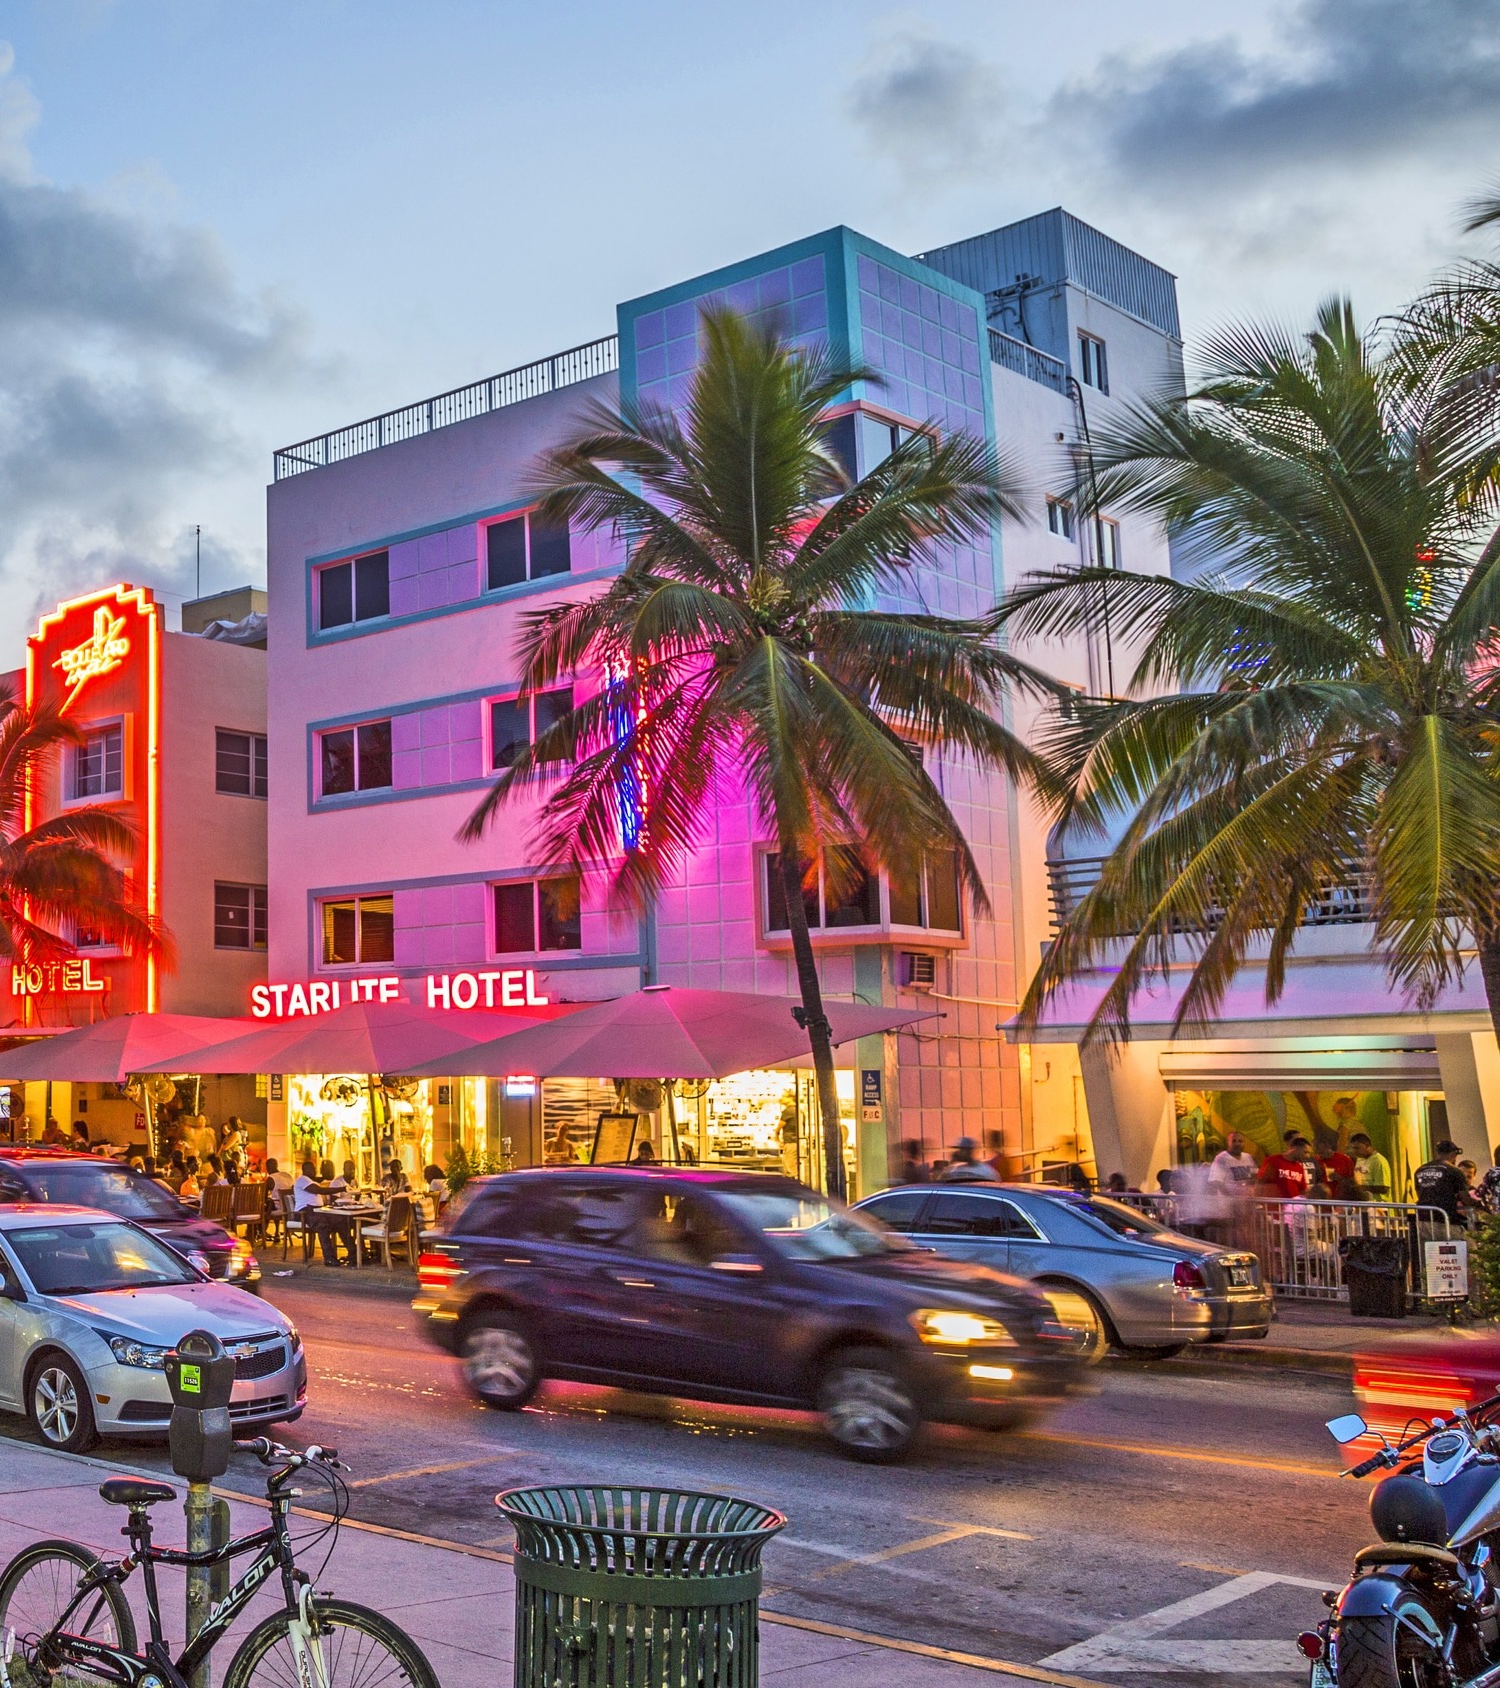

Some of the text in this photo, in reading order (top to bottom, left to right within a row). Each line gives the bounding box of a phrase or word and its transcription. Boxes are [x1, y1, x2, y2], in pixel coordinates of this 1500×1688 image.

[12, 959, 104, 995] HOTEL
[427, 970, 549, 1010] HOTEL
[201, 1555, 275, 1632] AVALON
[71, 1641, 102, 1653] AVALON
